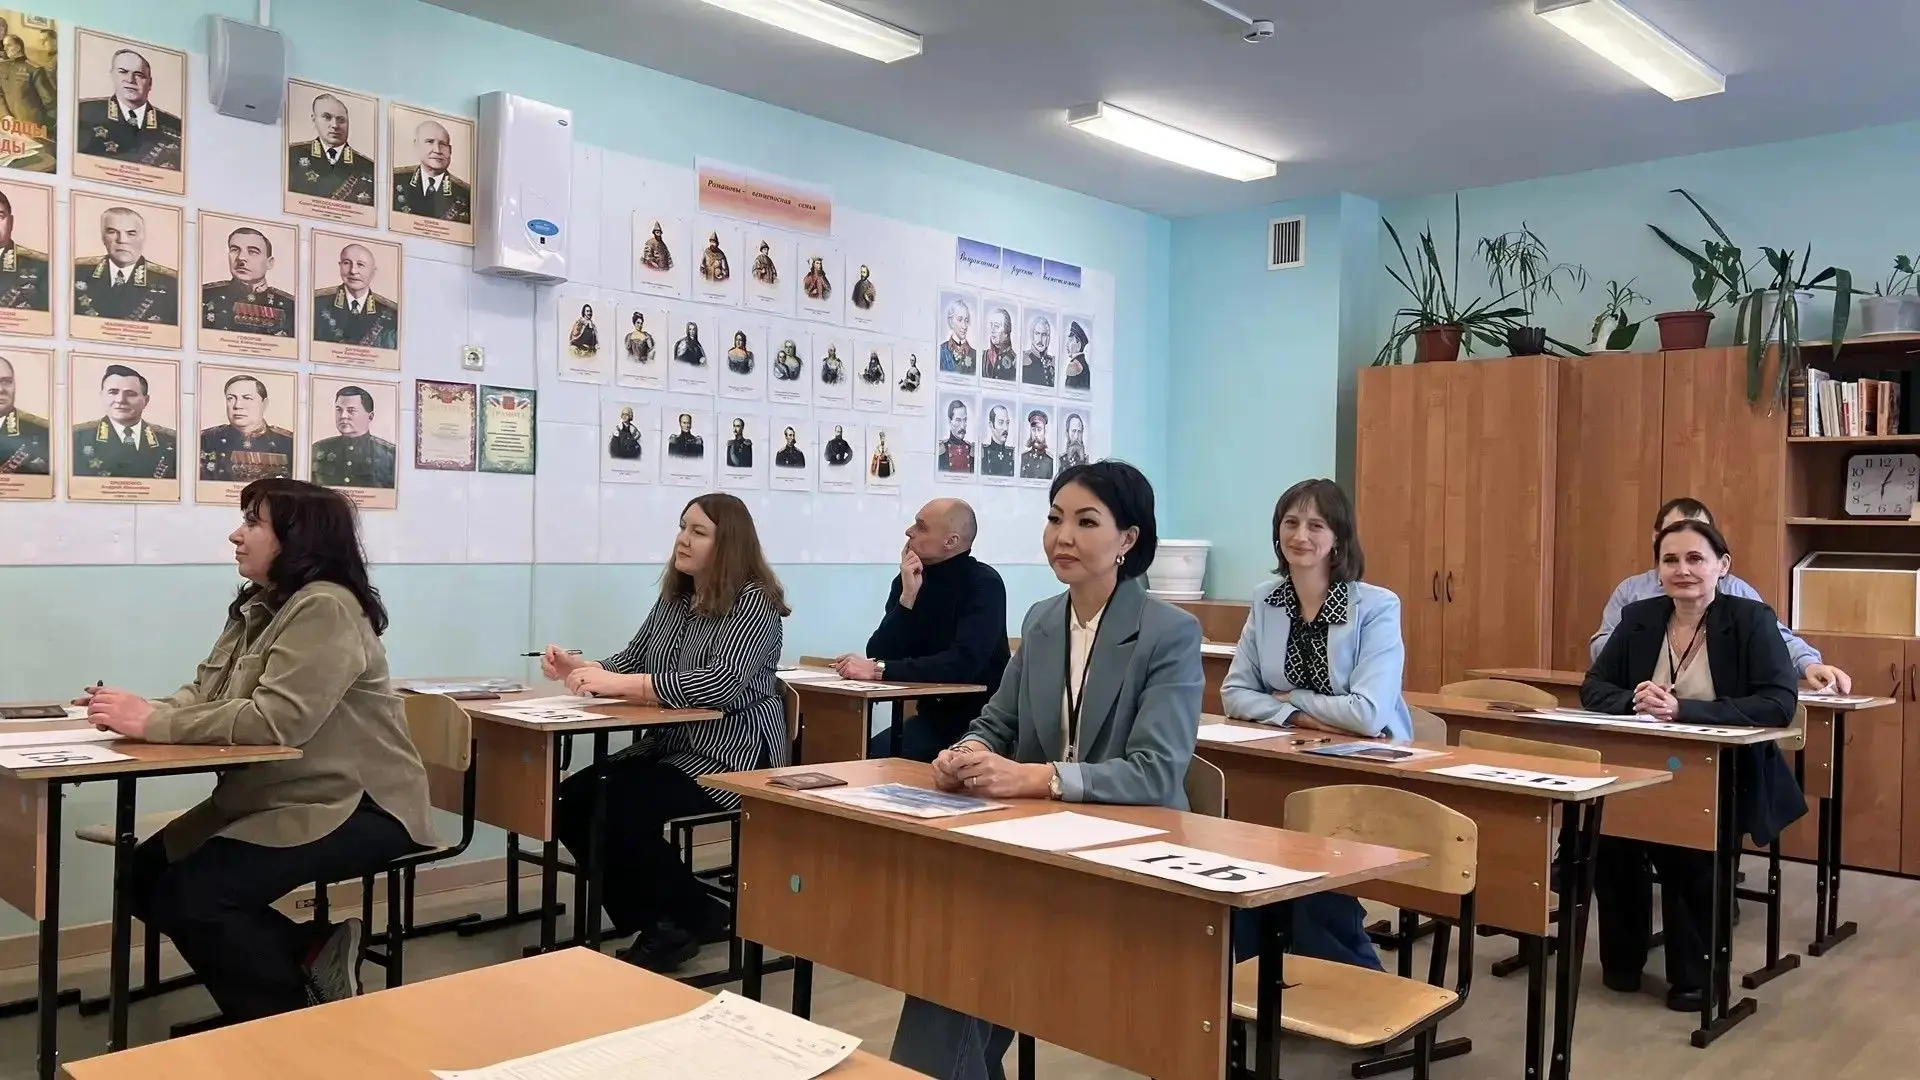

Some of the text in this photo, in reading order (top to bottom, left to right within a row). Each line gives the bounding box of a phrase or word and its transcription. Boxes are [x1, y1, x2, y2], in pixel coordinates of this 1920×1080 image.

[1866, 458, 1873, 468] 11
[1880, 457, 1892, 468] 12
[1852, 468, 1864, 477] 10
[1908, 467, 1916, 476] 2
[1852, 481, 1861, 491] 9
[1907, 480, 1915, 490] 3
[1852, 495, 1860, 504] 8
[1864, 503, 1871, 513] 7
[1878, 504, 1887, 513] 6
[1894, 504, 1902, 513] 5
